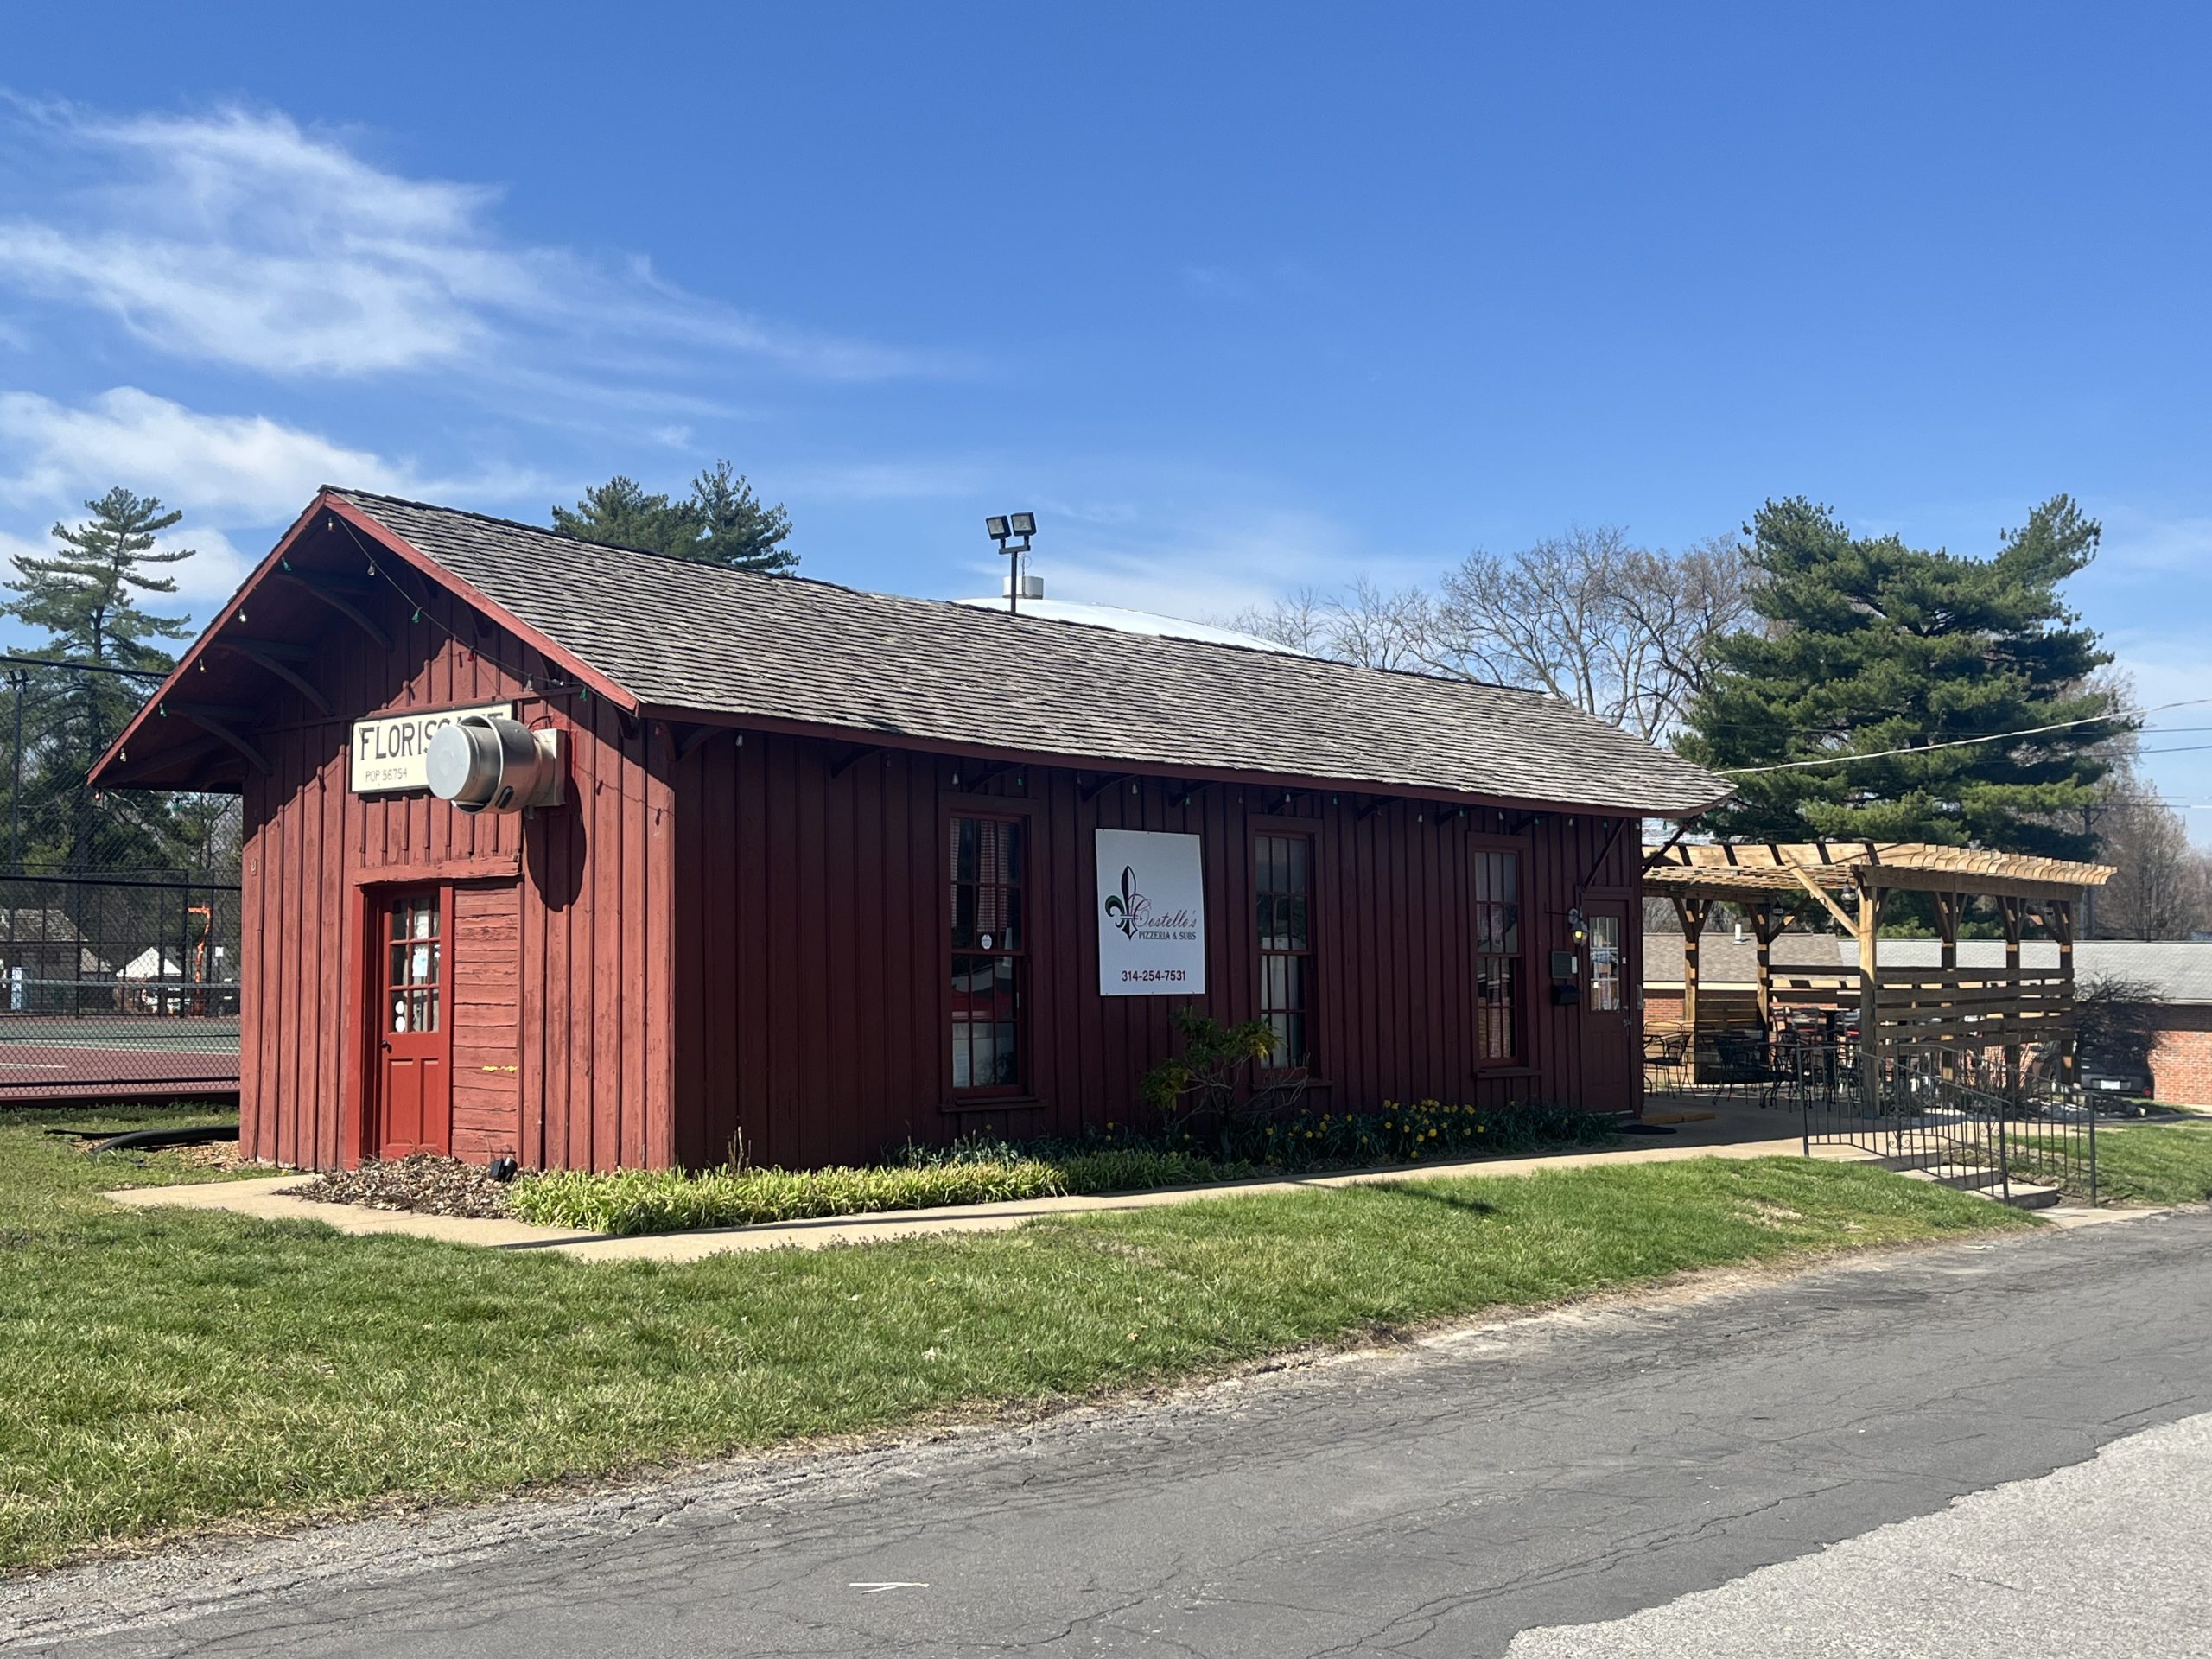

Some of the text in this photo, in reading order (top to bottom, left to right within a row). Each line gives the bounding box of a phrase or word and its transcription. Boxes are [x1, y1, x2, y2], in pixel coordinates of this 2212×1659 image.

[359, 713, 503, 760] FLORIS
[1128, 894, 1197, 928] Costello's
[1139, 931, 1170, 940] PIZZERIA
[1173, 931, 1177, 940] &
[1122, 970, 1186, 982] 314-254-7531
